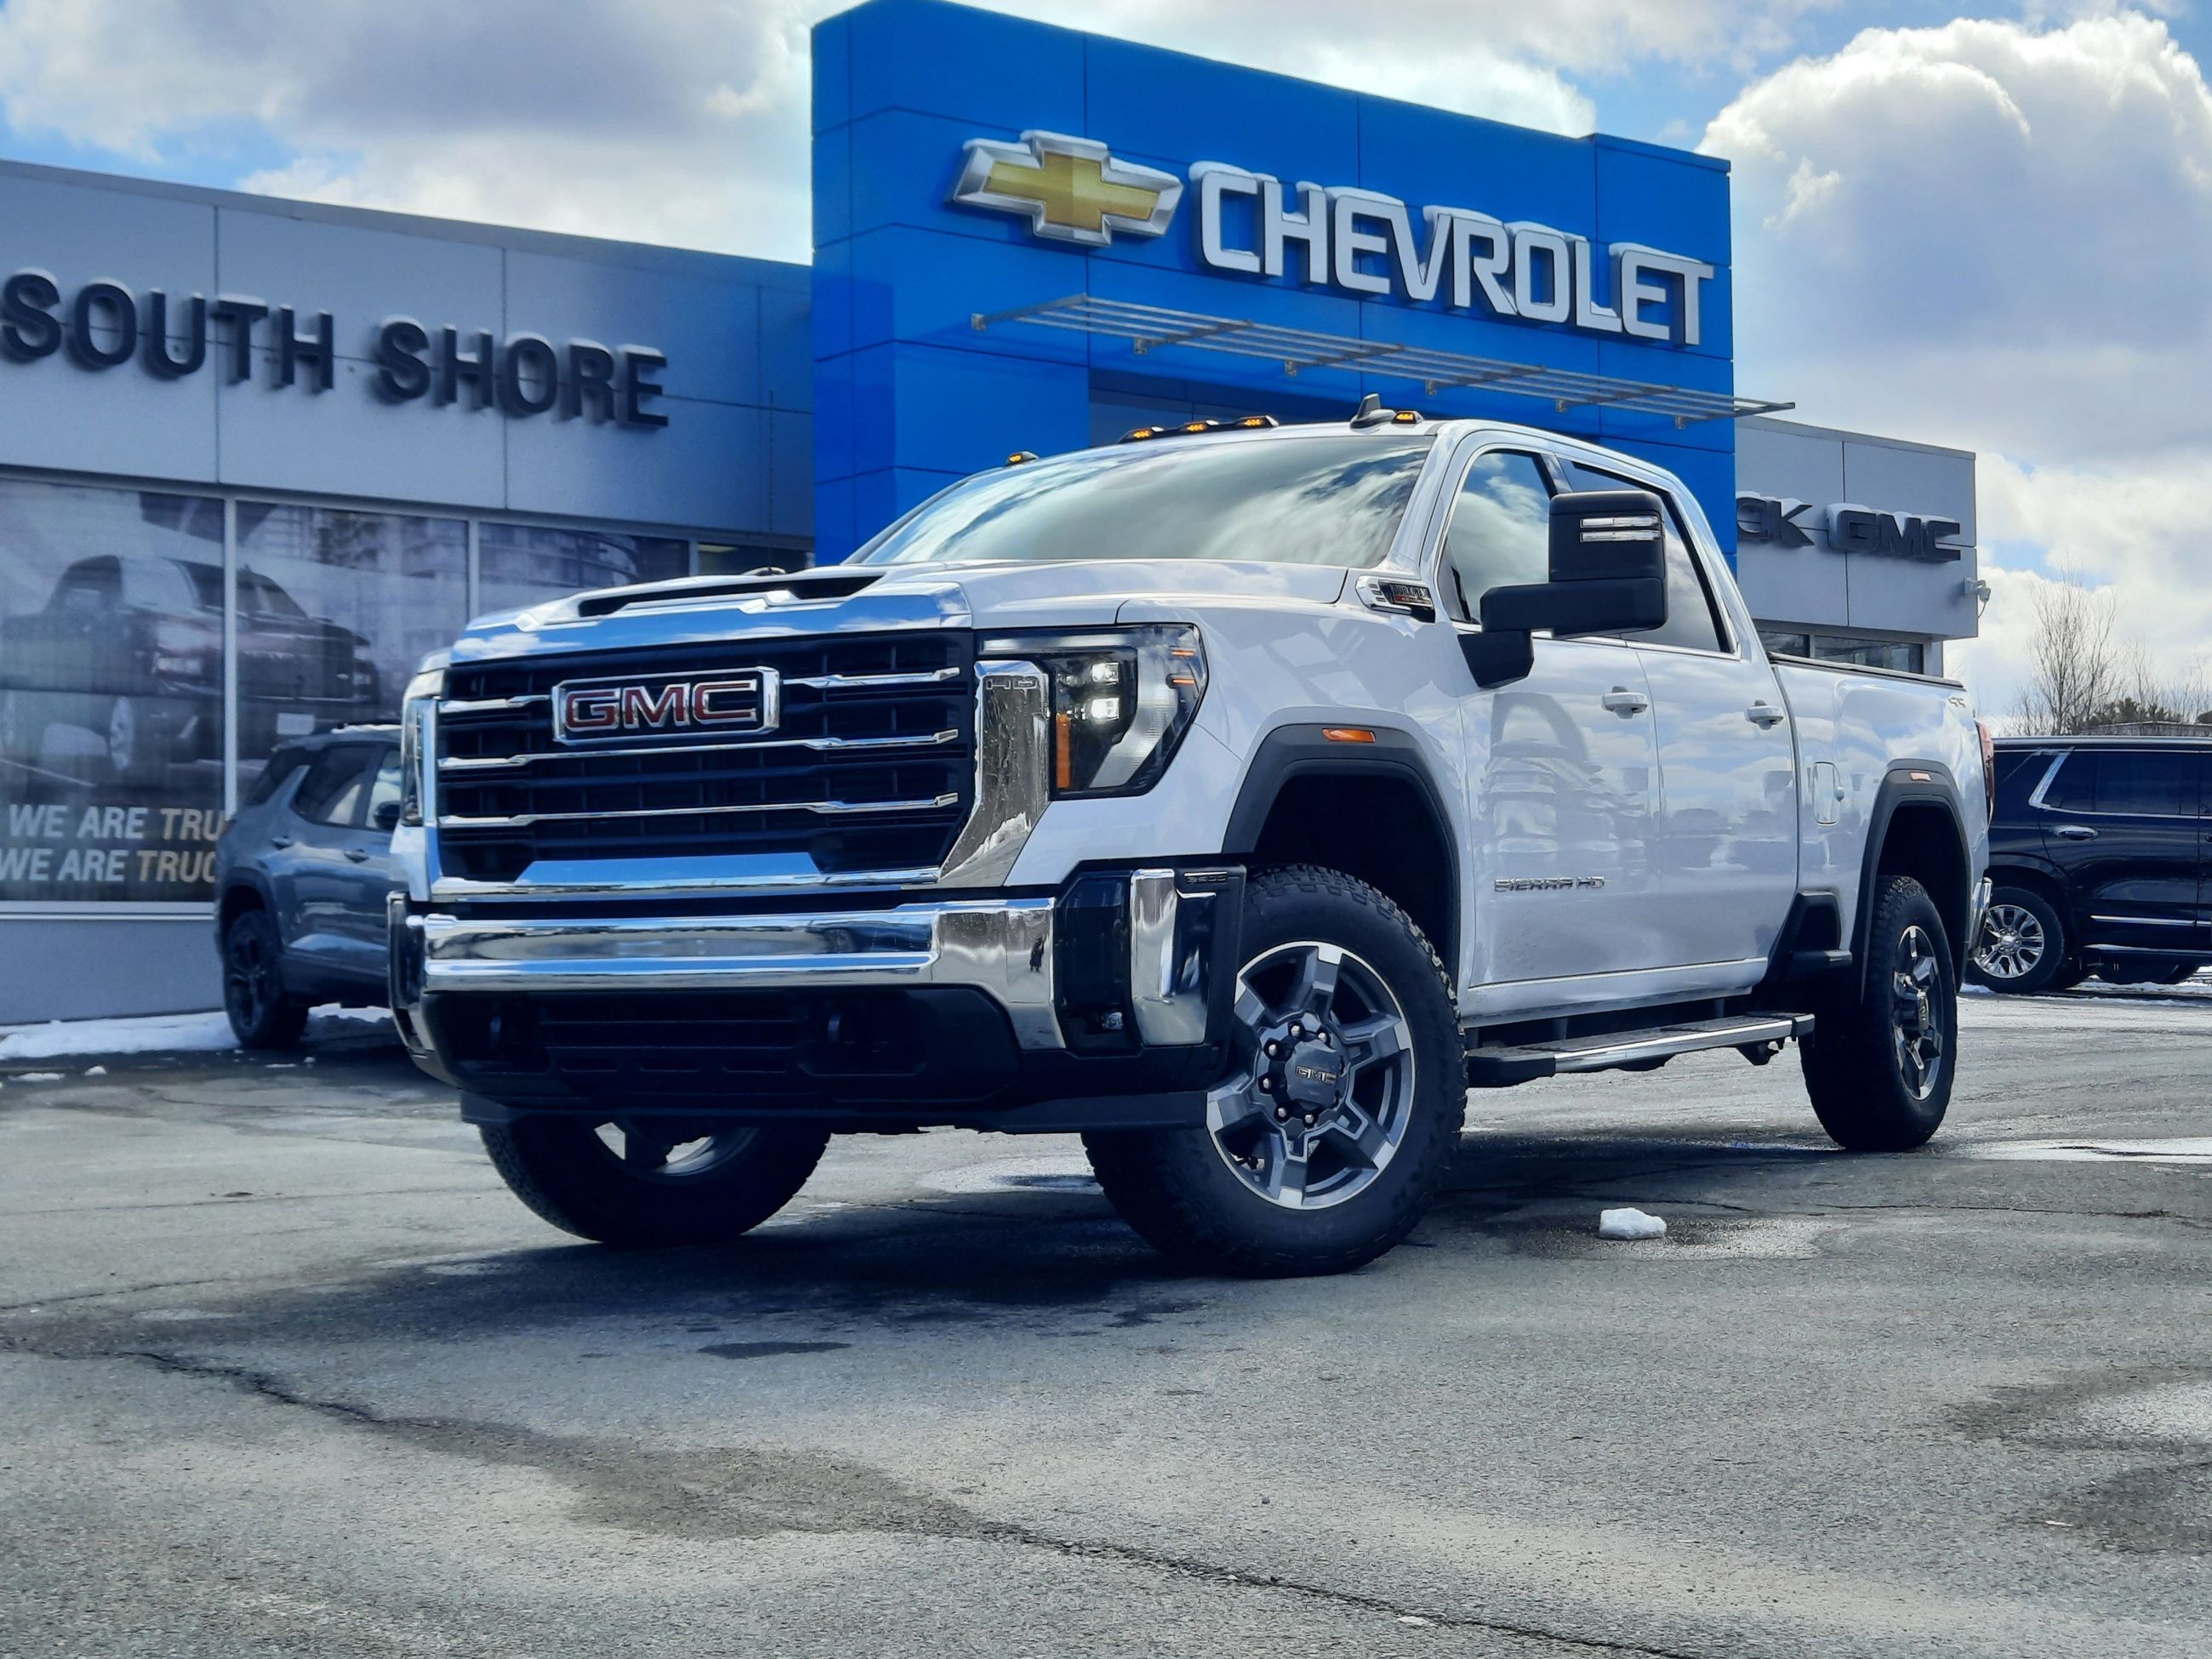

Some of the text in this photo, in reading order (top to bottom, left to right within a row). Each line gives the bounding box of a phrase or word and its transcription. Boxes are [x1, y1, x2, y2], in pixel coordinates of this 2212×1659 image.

[1193, 163, 1714, 346] CHEVROLET
[2, 270, 669, 428] SOUTH SHORE
[1827, 506, 1961, 562] GMC
[565, 678, 757, 733] GMC
[9, 804, 68, 838] WE
[77, 806, 149, 840] ARE
[0, 848, 53, 881] WE
[57, 849, 129, 881] ARE
[1494, 875, 1605, 892] SIERRA HD
[1296, 1066, 1337, 1084] GMC
